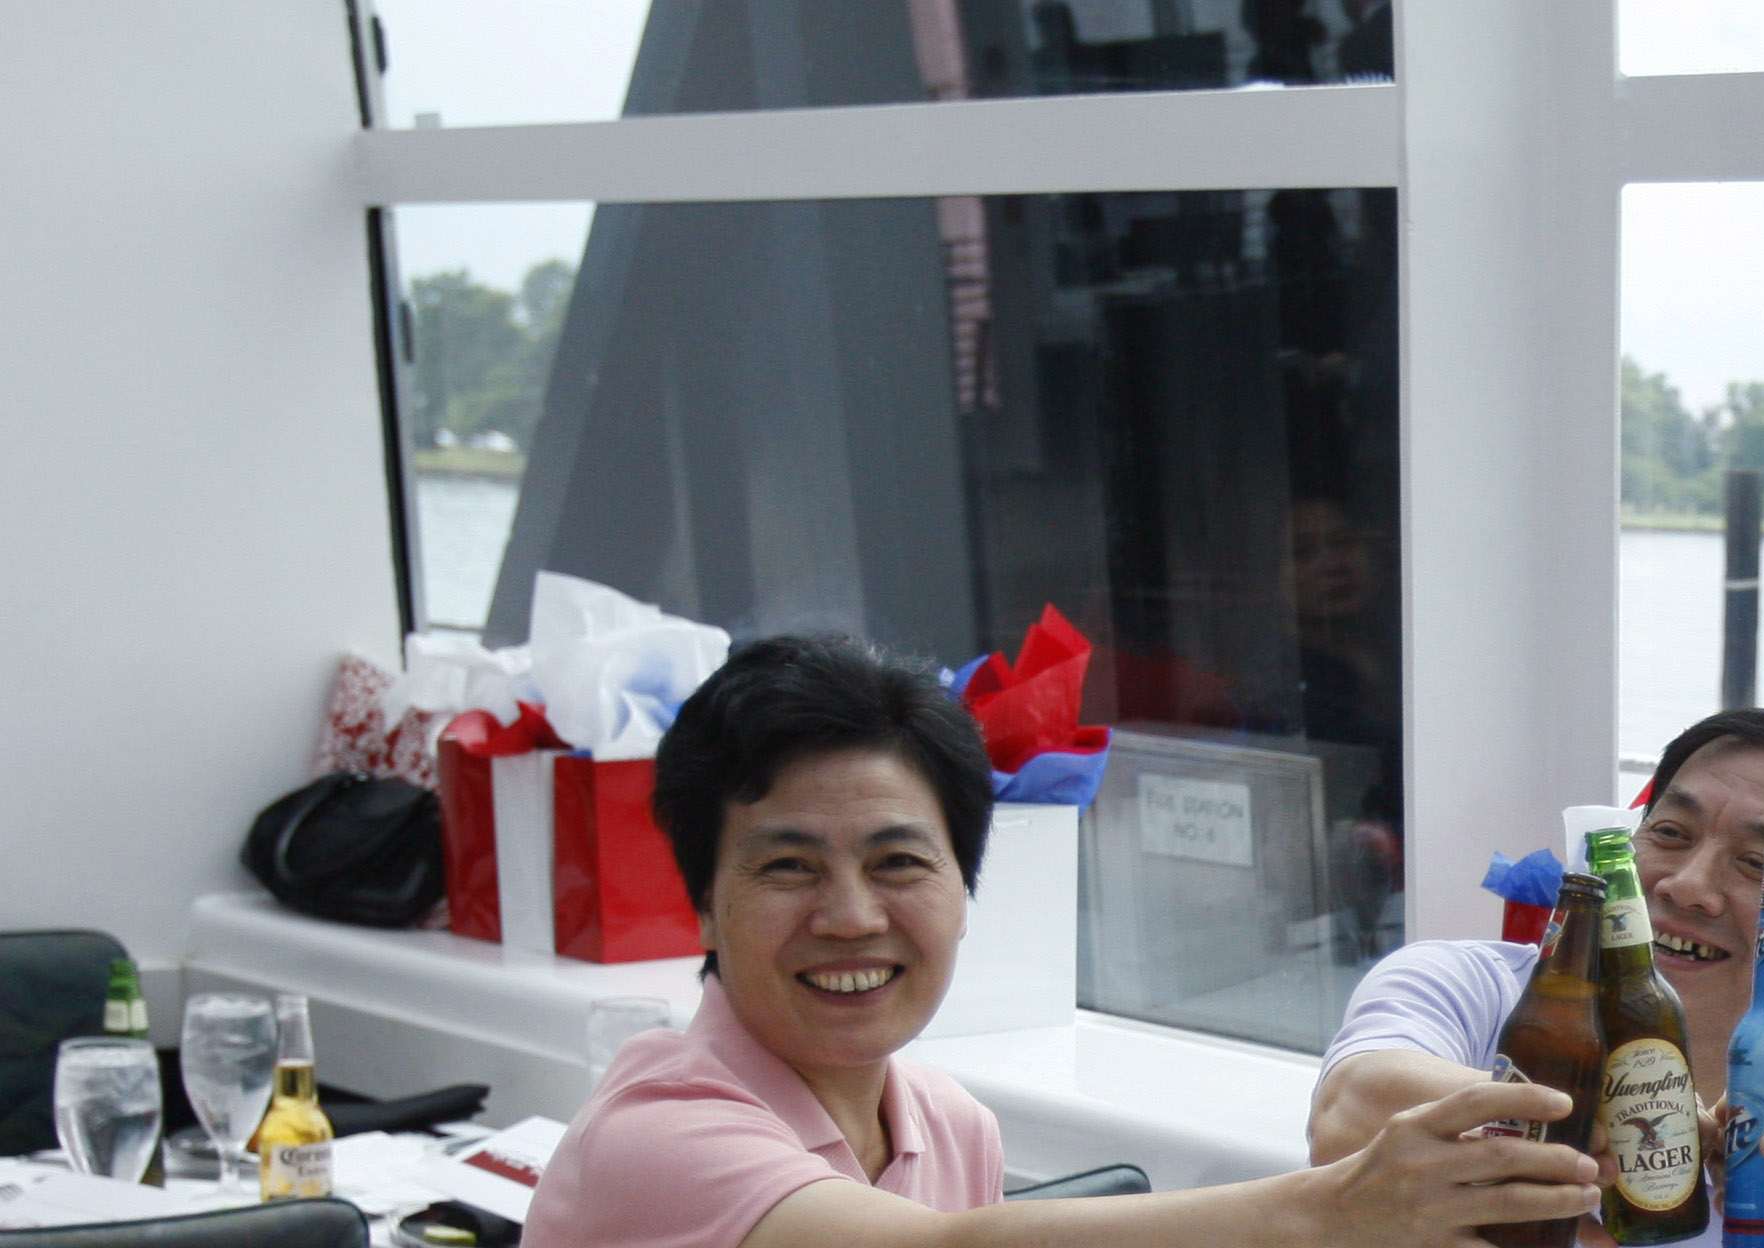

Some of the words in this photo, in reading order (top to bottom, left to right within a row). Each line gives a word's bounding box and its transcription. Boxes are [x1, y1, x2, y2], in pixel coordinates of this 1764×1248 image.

[1601, 1070, 1690, 1103] Yuengling
[1615, 1100, 1685, 1122] TRADITIONAL
[1618, 1145, 1693, 1173] LAGER
